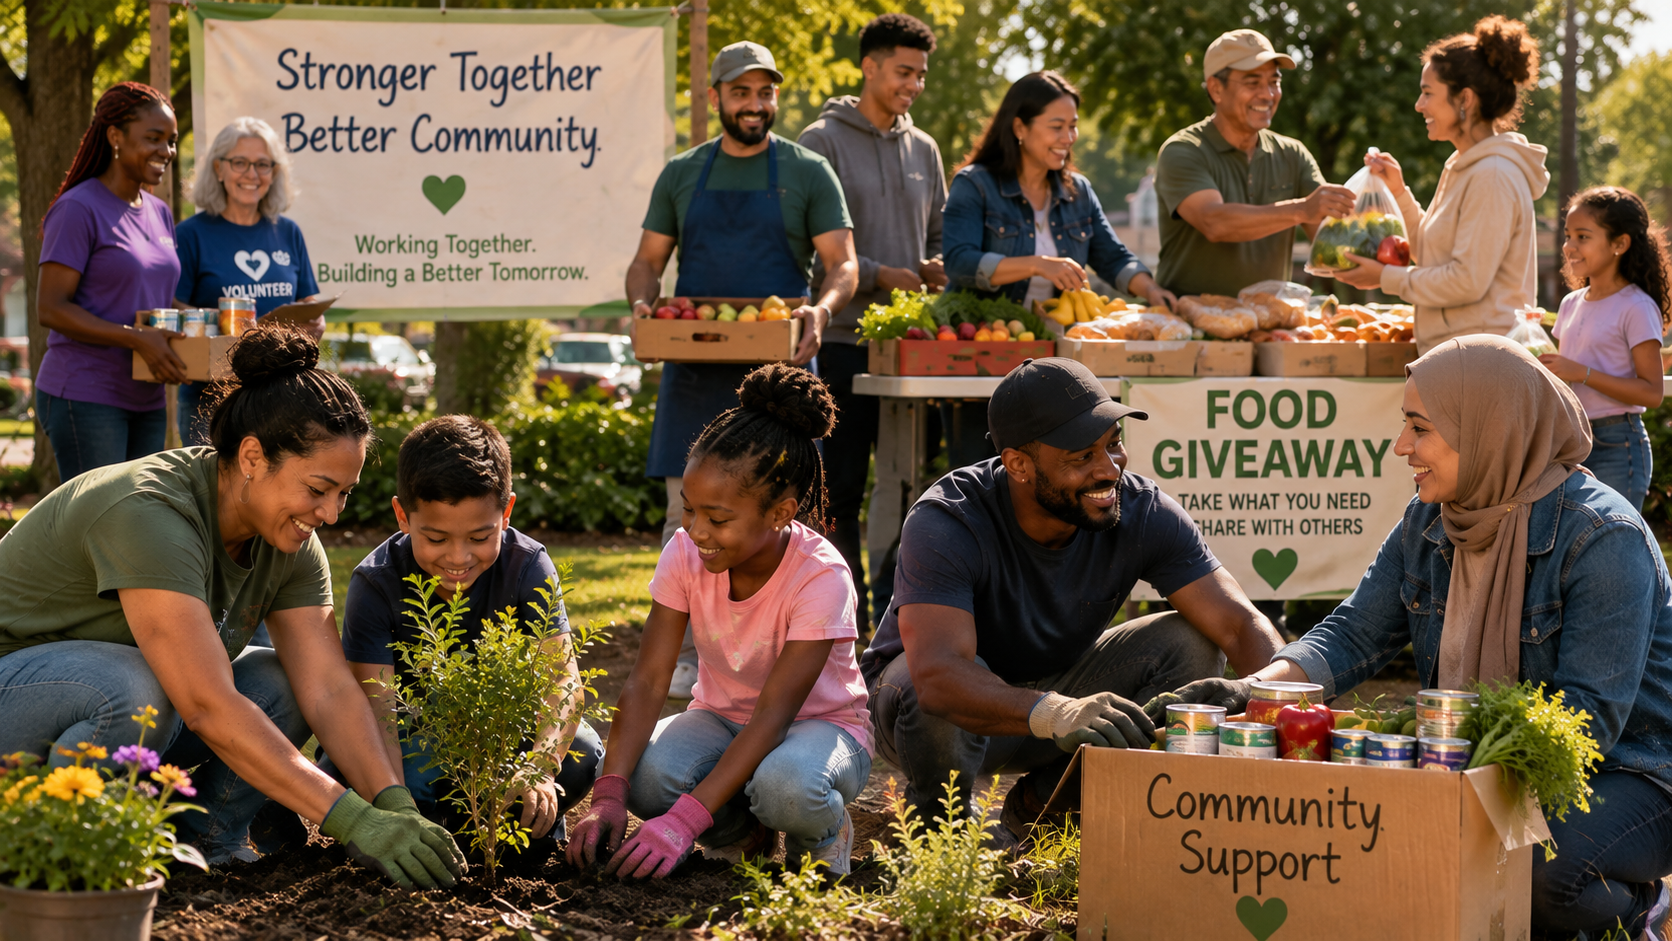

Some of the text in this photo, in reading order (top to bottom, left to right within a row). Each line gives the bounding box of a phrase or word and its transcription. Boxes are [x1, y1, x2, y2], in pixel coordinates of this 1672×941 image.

[276, 48, 602, 108] Stronger Together
[281, 112, 397, 153] Better
[354, 234, 537, 260] Working Together.
[221, 282, 293, 298] VOLUNTEER
[317, 262, 590, 288] Building a Better Tomorrow.
[1206, 389, 1338, 430] FOOD
[1152, 438, 1392, 479] GIVEAWAY
[1178, 493, 1372, 511] TAKE WHAT YOU NEED
[1251, 519, 1294, 536] WITH
[1300, 518, 1364, 536] OTHERS
[1179, 829, 1342, 896] Support
